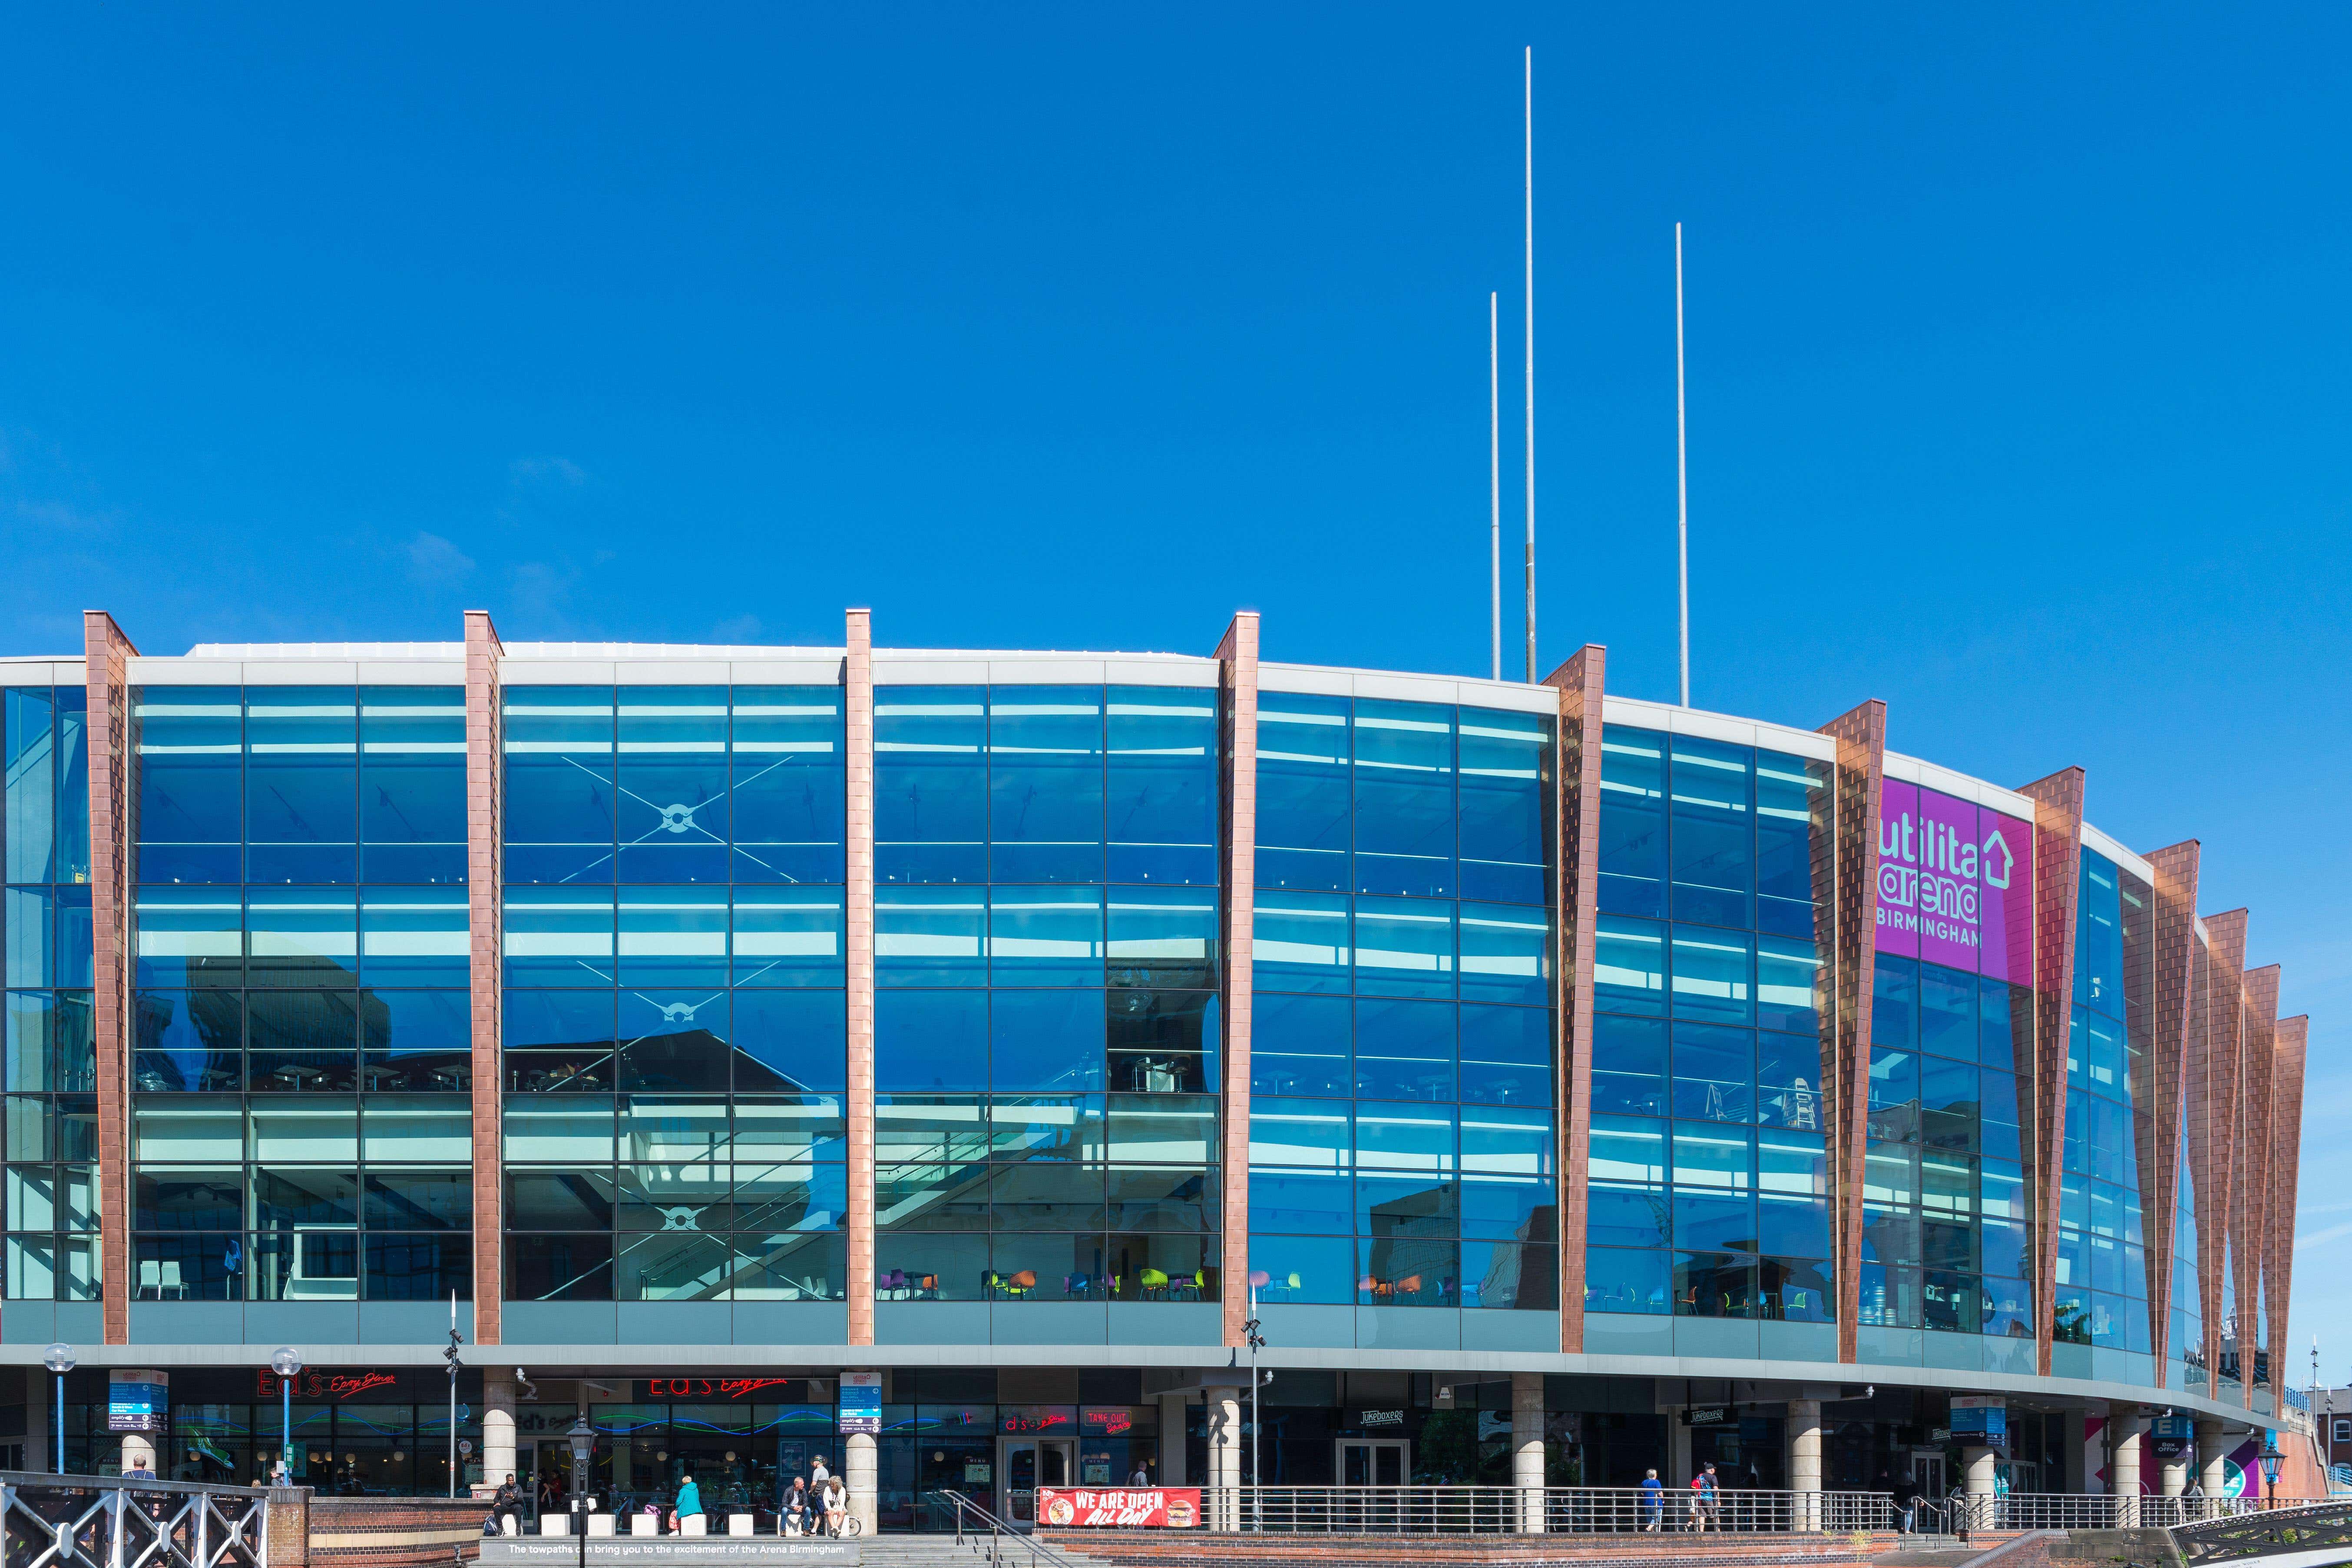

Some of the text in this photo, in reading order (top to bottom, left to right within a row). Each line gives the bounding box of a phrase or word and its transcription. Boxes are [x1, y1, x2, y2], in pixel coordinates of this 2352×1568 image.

[1879, 813, 1981, 881] utilita
[1878, 863, 1982, 925] arena
[1876, 907, 1982, 949] BIRMINGHAM
[1088, 1413, 1126, 1422] TAKE OUT
[2158, 1419, 2172, 1434] E
[1075, 1492, 1163, 1509] WE ARE OPEN
[1084, 1507, 1154, 1526] ALL DAY
[509, 1545, 526, 1554] The
[529, 1545, 573, 1555] towpaths
[595, 1545, 620, 1555] bring
[622, 1546, 641, 1555] you
[656, 1545, 672, 1553] the
[674, 1545, 726, 1554] excitement
[729, 1545, 739, 1554] of
[741, 1545, 757, 1554] the
[760, 1545, 787, 1554] Arena
[790, 1545, 844, 1555] Birmingham
